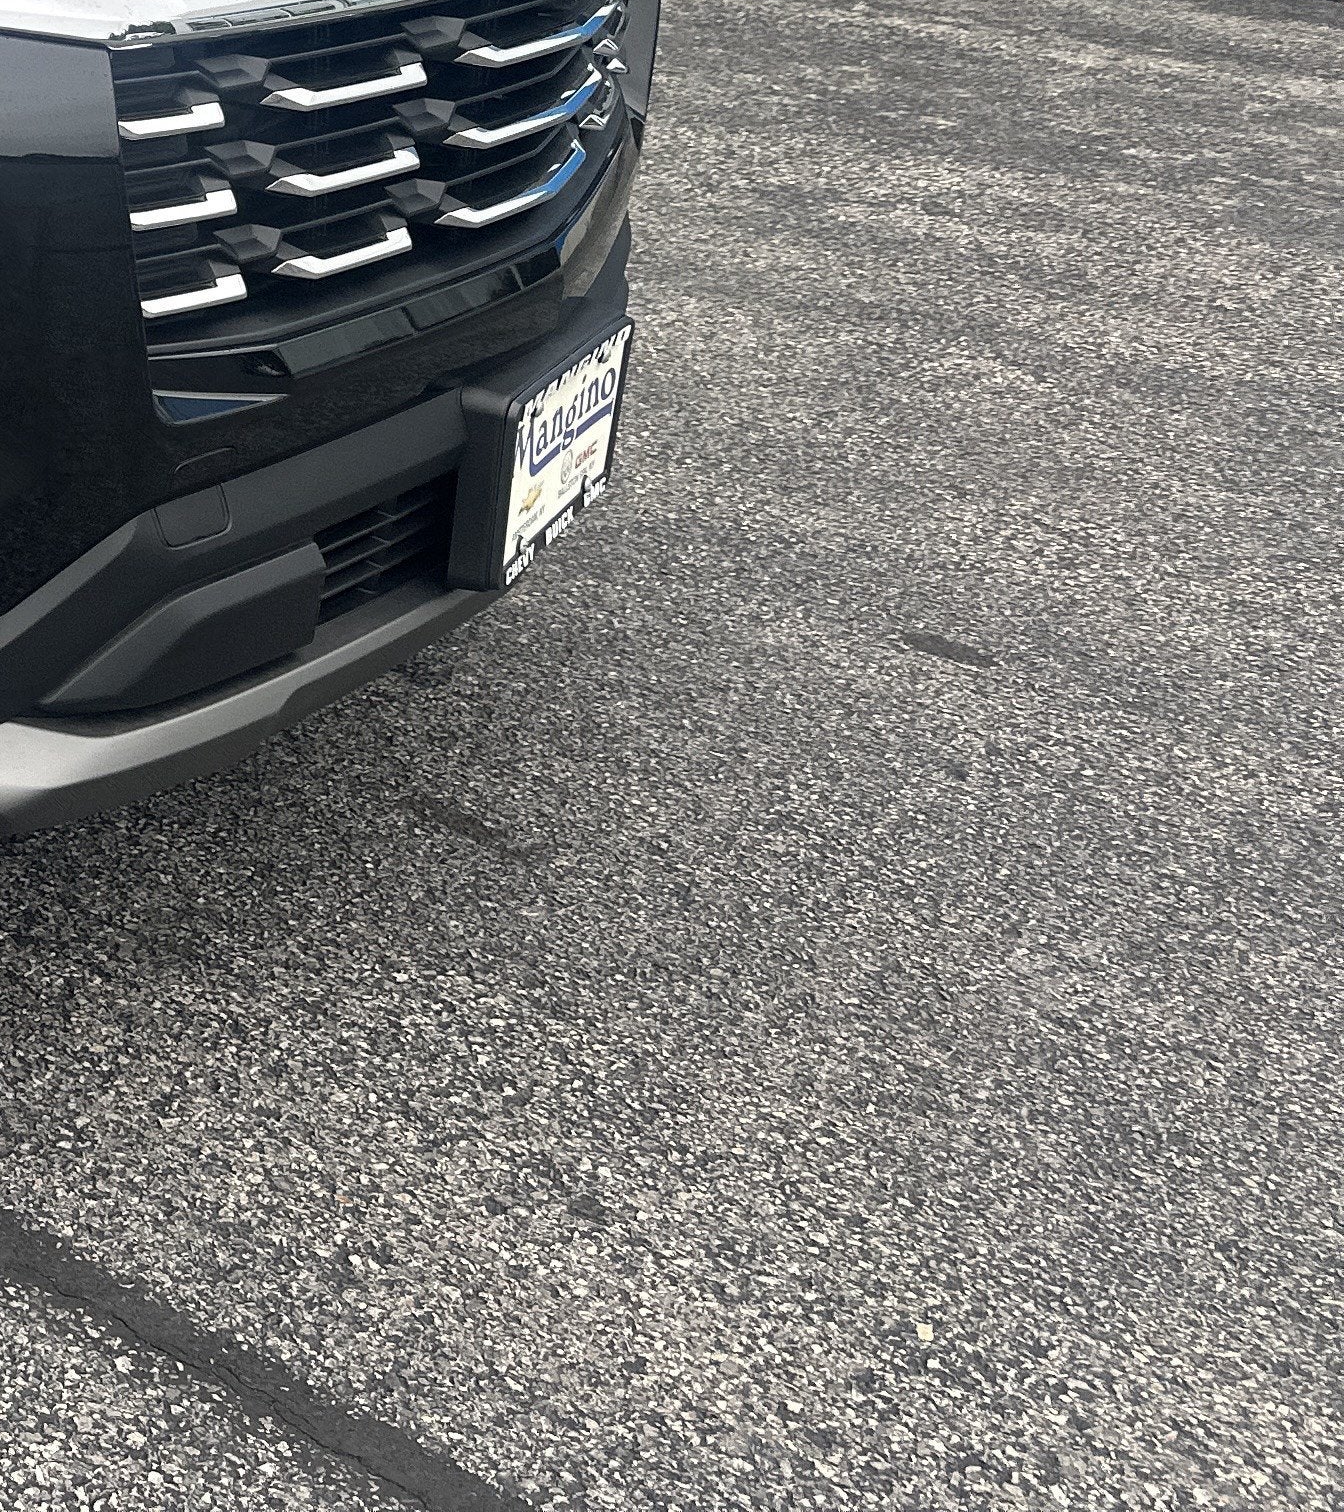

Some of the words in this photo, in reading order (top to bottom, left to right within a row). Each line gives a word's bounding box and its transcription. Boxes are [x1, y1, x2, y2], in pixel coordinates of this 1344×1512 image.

[514, 367, 617, 476] Mangino
[575, 440, 598, 469] GMC
[584, 477, 607, 507] GMC
[546, 506, 574, 546] BUICK
[506, 543, 535, 586] CHEVY
